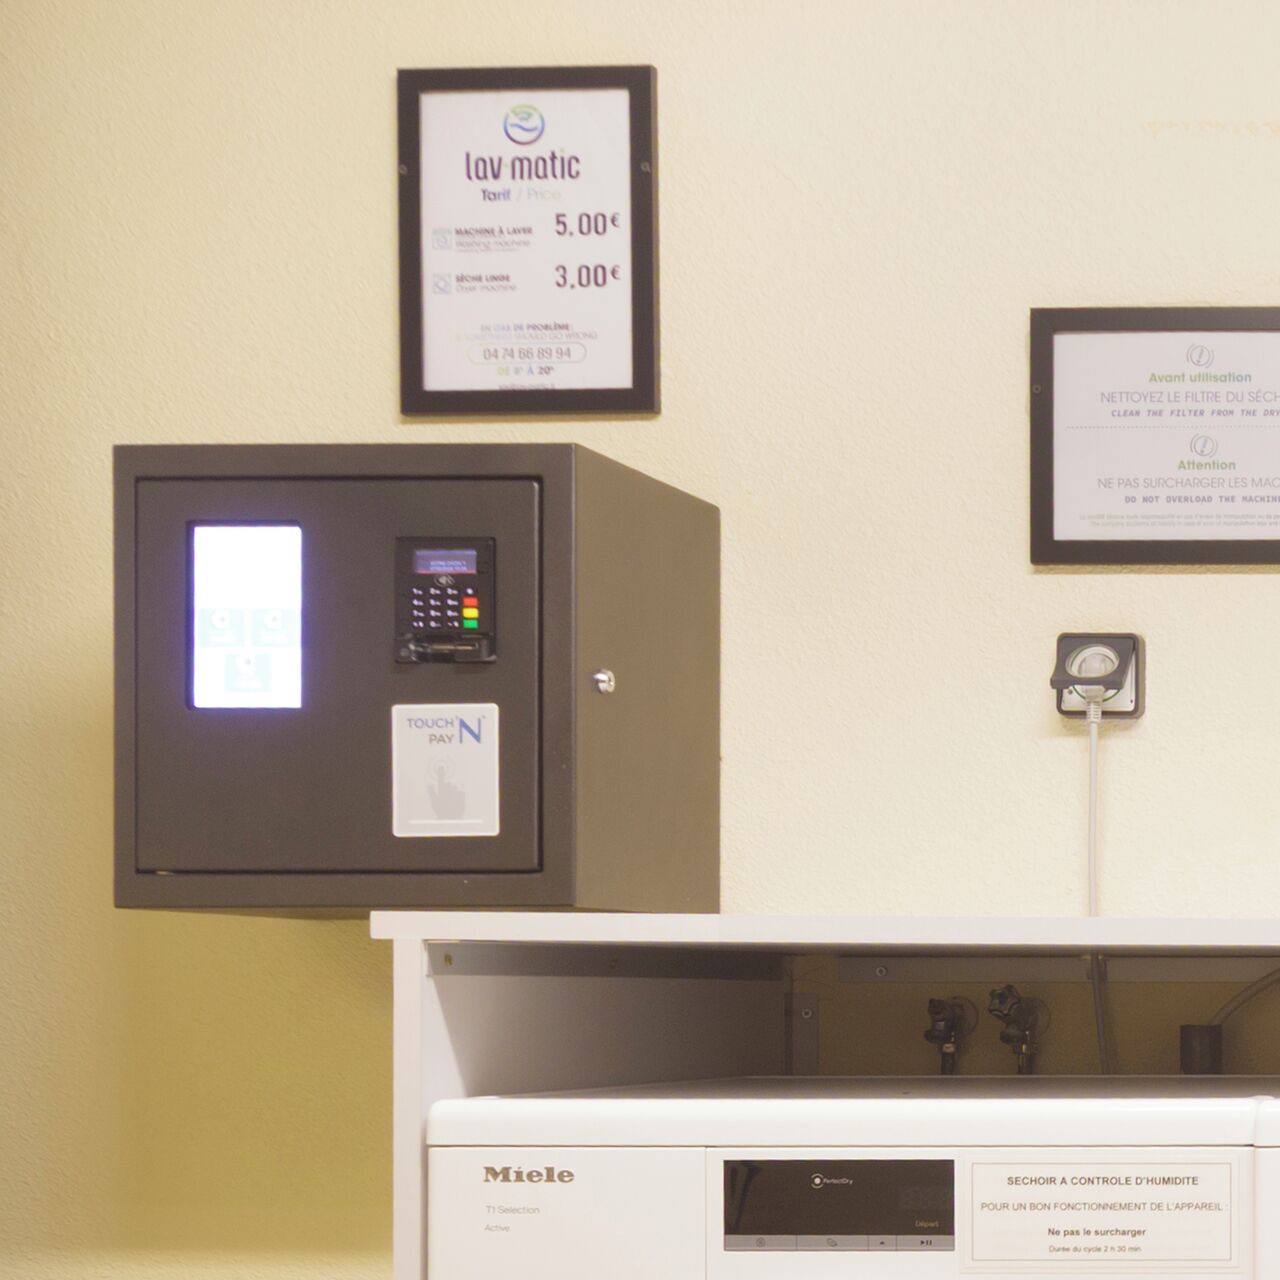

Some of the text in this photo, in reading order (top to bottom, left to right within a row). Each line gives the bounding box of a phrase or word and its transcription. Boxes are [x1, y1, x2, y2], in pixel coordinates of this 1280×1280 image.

[1148, 371, 1253, 384] Avant utilisation
[1099, 390, 1165, 404] NETTOYEZ
[1166, 390, 1182, 404] LE
[1183, 390, 1222, 404] FILTRE
[1224, 390, 1245, 404] DU
[1110, 408, 1142, 418] CLEAN
[1145, 408, 1165, 418] THE
[1168, 408, 1206, 418] FILTER
[1209, 408, 1236, 417] FROM
[1239, 408, 1258, 417] THE
[1176, 459, 1237, 471] Attention
[1096, 476, 1115, 490] NE
[1116, 476, 1141, 490] PAS
[1142, 476, 1226, 490] SURCHARGER
[1227, 476, 1249, 489] LES
[1123, 495, 1138, 504] DO
[1141, 495, 1161, 504] NOT
[1164, 494, 1214, 504] OVERLOAD
[1217, 494, 1237, 504] THE
[405, 717, 455, 729] TOUCH
[428, 734, 455, 745] PAY
[482, 1165, 575, 1184] Miele
[1006, 1175, 1058, 1186] SECHOIR
[1059, 1176, 1068, 1186] A
[1070, 1175, 1133, 1186] CONTROLE
[979, 1201, 1011, 1212] POUR
[1011, 1202, 1028, 1212] UN
[1028, 1201, 1052, 1212] BON
[1052, 1201, 1148, 1212] FONCTIONNEMENT
[1149, 1201, 1165, 1212] DE
[1047, 1227, 1147, 1239] Ne pas le surcharger
